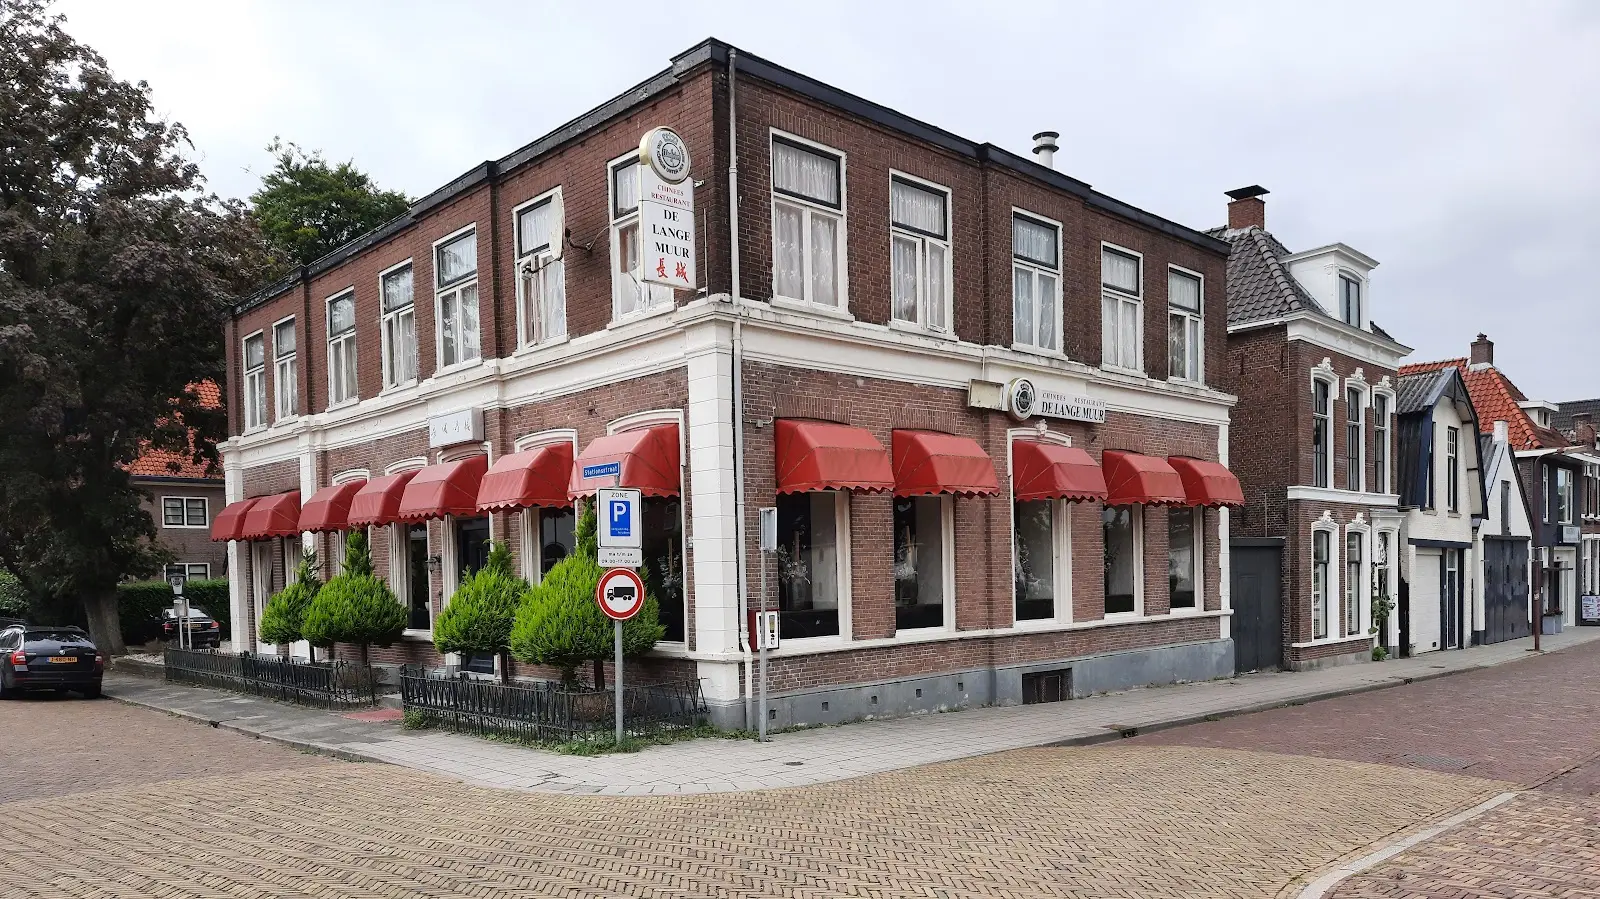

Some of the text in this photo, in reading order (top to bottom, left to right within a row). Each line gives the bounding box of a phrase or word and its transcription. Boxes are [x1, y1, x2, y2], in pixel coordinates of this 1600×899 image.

[657, 184, 684, 196] CHINEES
[651, 192, 690, 207] RESTAURANT
[664, 209, 680, 222] DE
[652, 224, 691, 242] LANGE
[655, 242, 690, 258] MUUR
[1042, 392, 1104, 407] CHINEES RESTAURANT
[1042, 402, 1104, 420] DE LANGE MUUR
[584, 466, 618, 476] Stationsstraat
[614, 502, 627, 522] P
